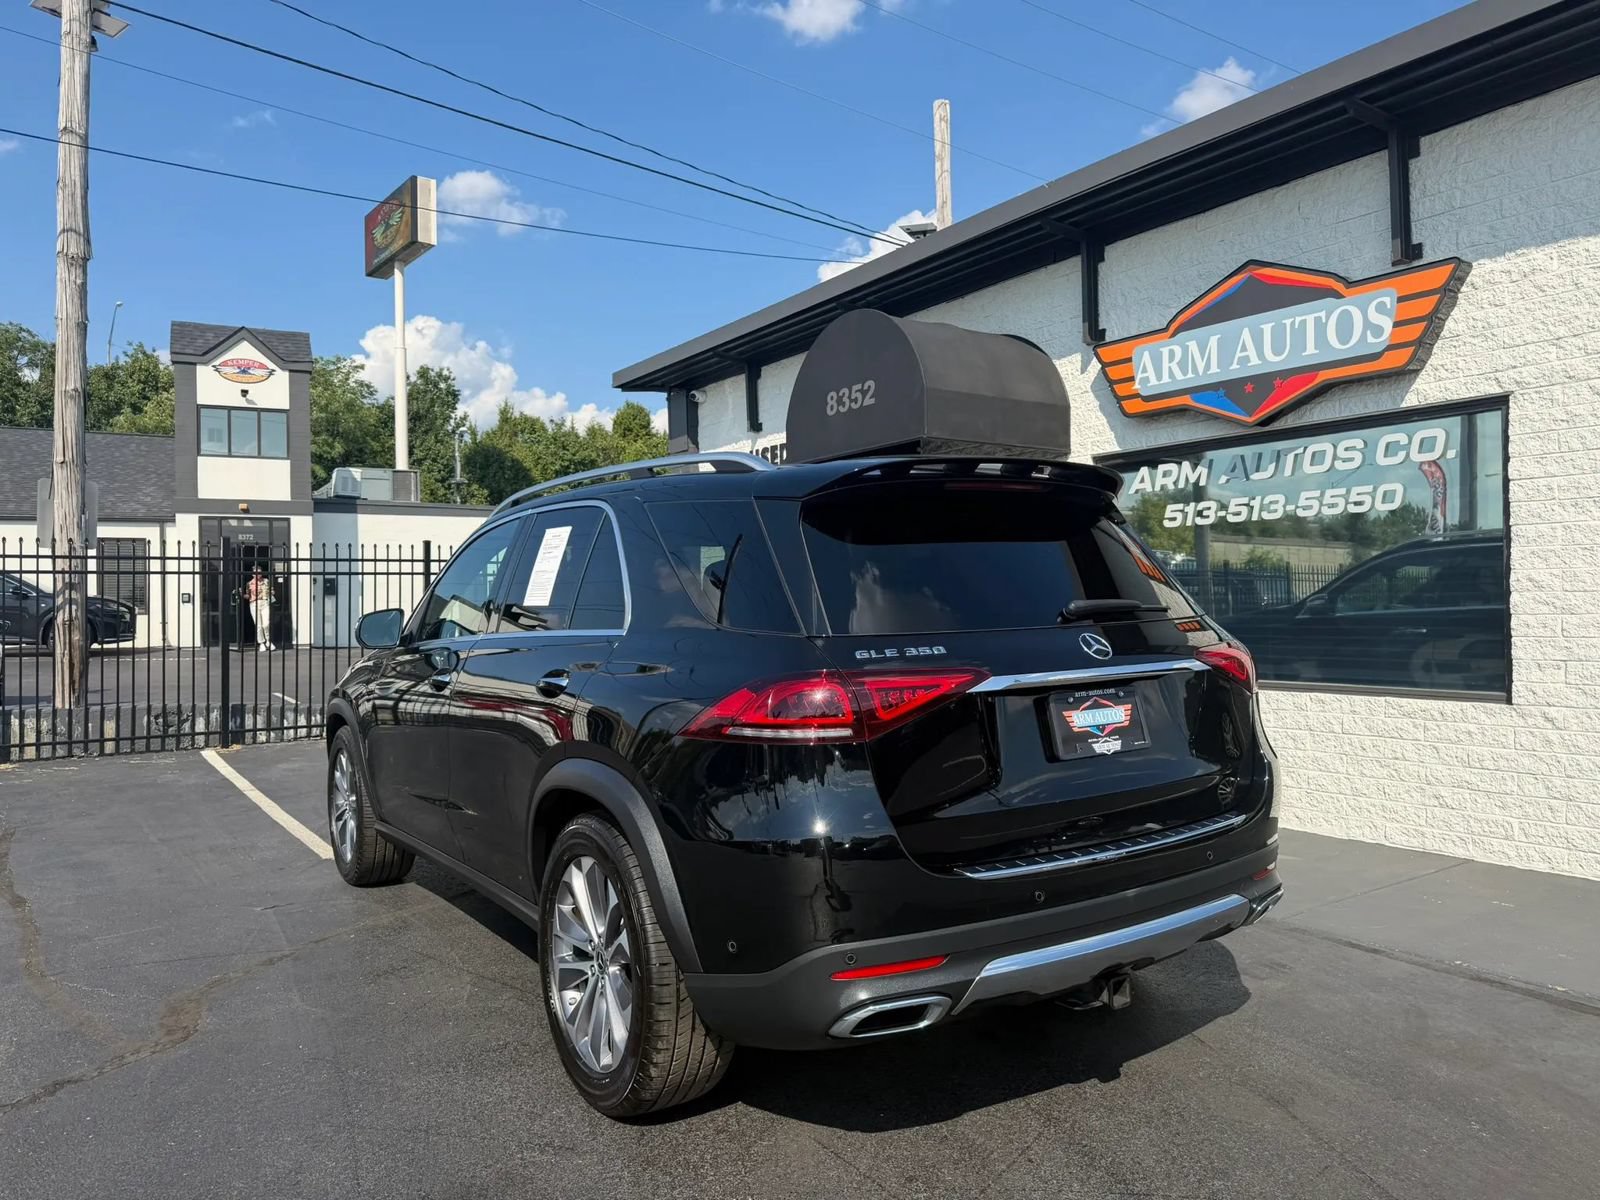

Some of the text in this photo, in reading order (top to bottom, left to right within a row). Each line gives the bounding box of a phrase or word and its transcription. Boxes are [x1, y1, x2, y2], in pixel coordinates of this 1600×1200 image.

[1133, 296, 1393, 389] ARM AUTOS
[826, 380, 876, 416] 8352
[1128, 427, 1457, 494] ARM AUTOS CO.
[1162, 483, 1404, 528] 513-513-5550
[855, 646, 948, 659] GLE 350
[1074, 709, 1124, 726] ARM AUTOS
